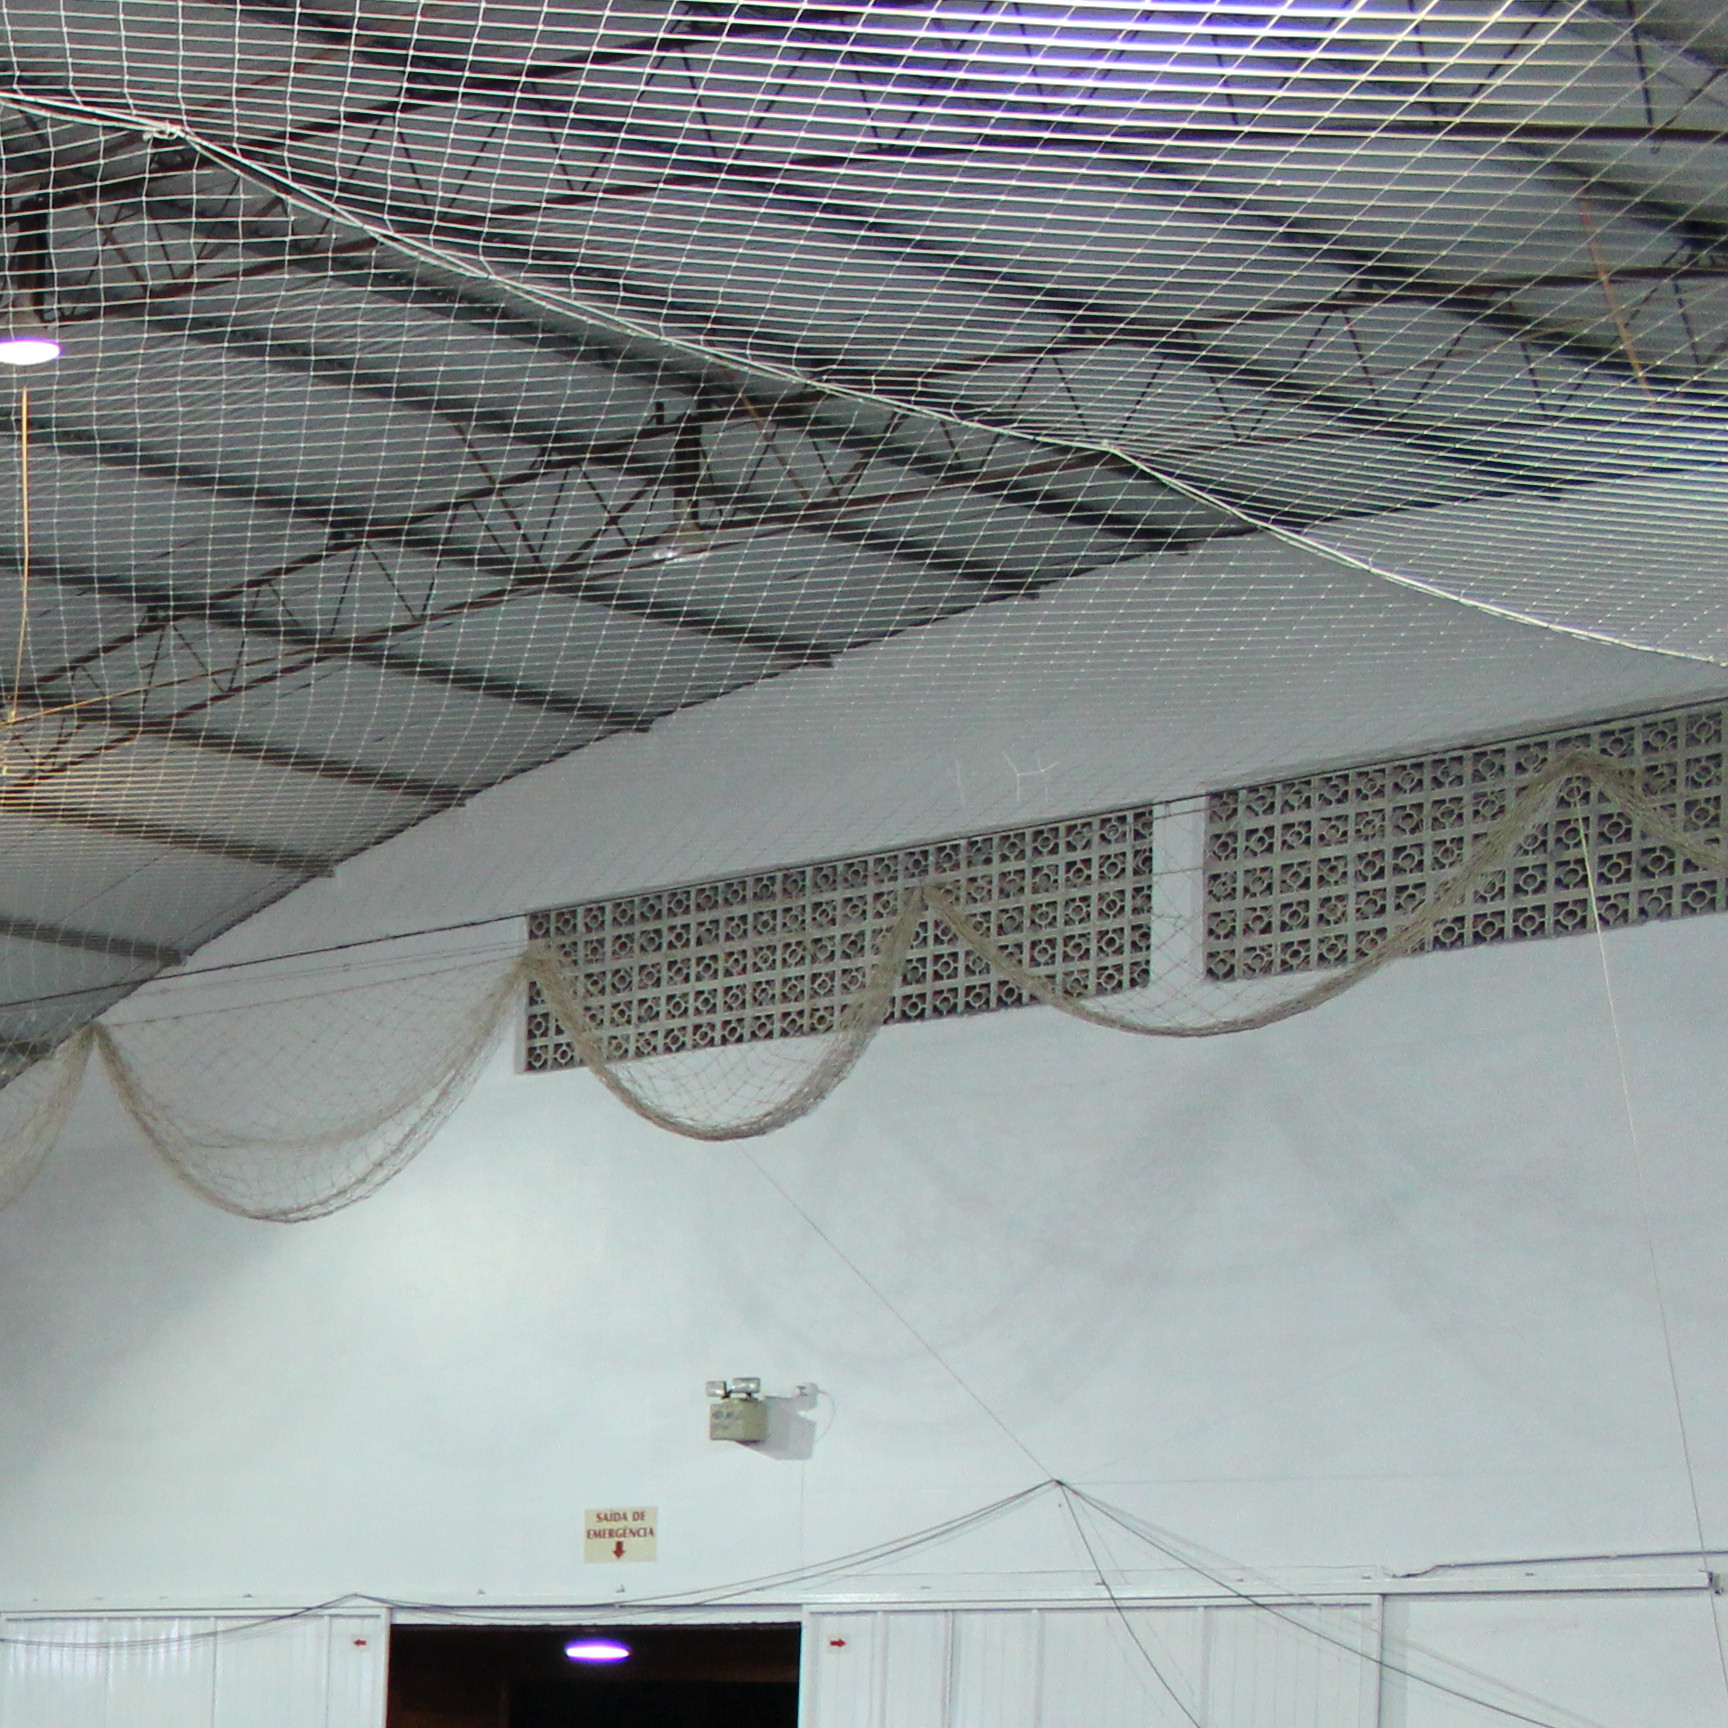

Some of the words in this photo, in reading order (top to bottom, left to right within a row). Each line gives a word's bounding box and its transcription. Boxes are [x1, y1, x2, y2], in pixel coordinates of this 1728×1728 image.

[596, 1509, 628, 1523] SAÍDA
[632, 1511, 646, 1521] DE
[586, 1525, 655, 1539] EMERGÊNCIA
